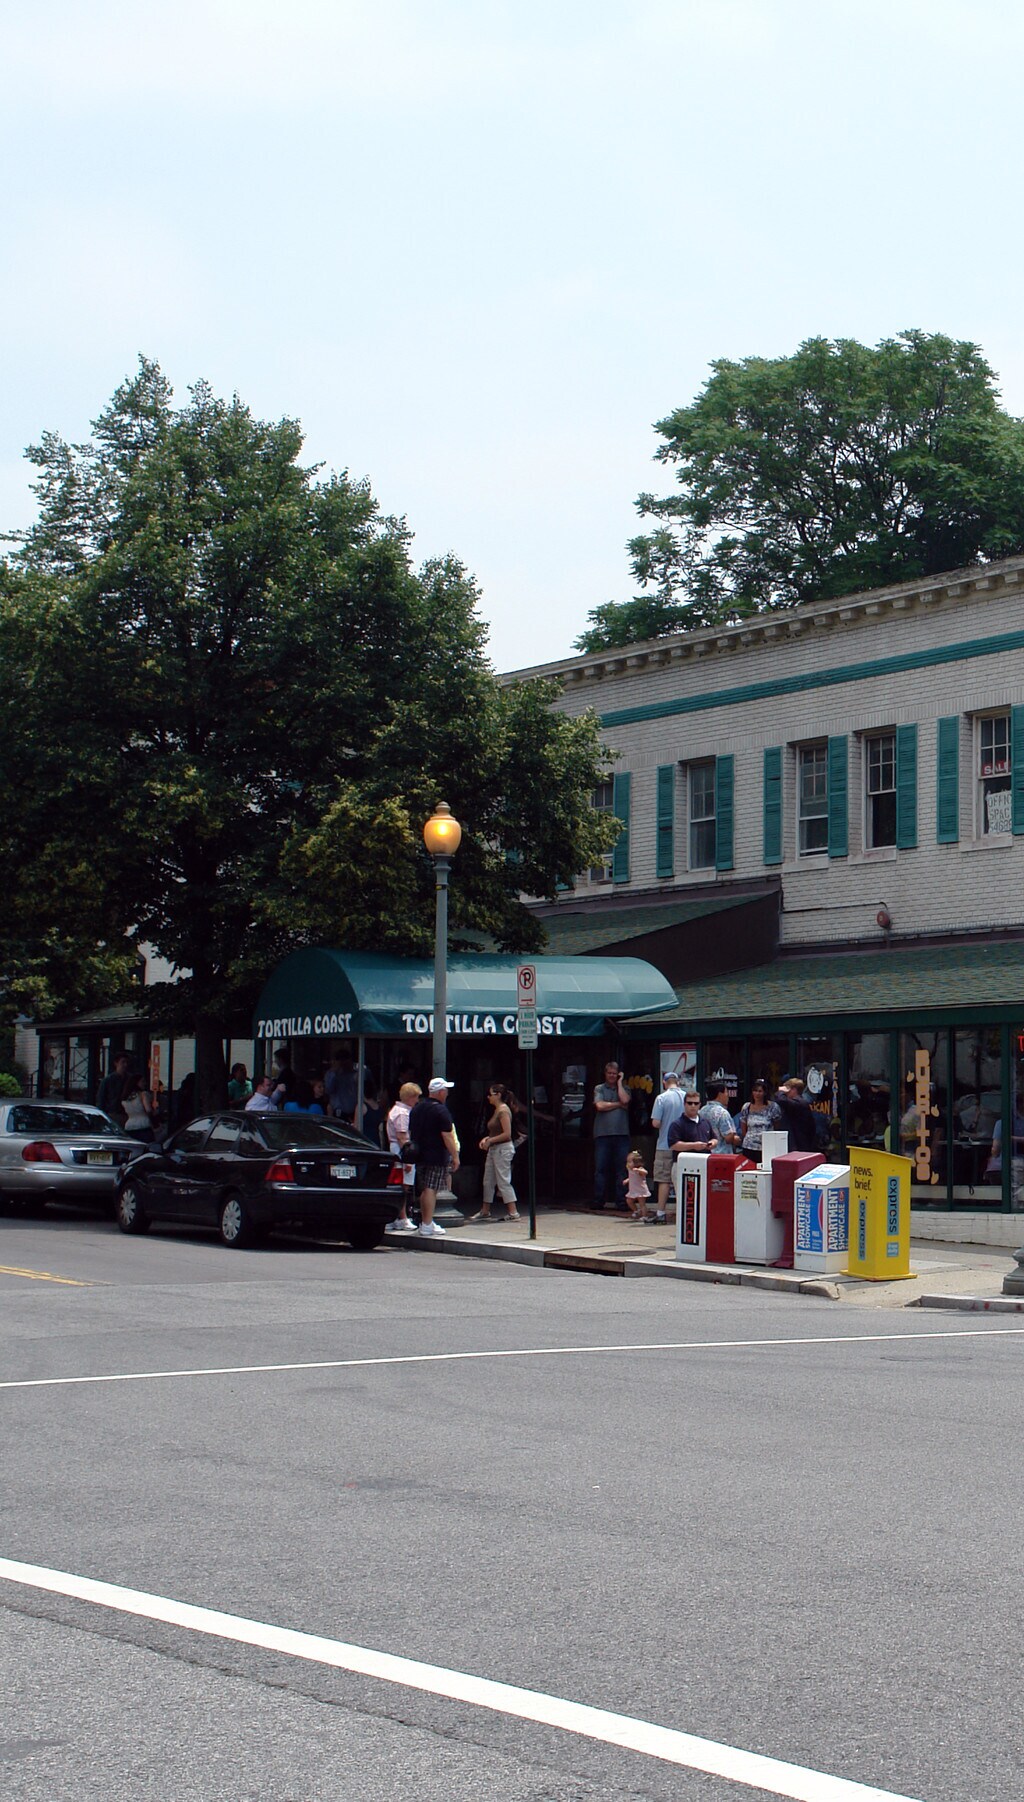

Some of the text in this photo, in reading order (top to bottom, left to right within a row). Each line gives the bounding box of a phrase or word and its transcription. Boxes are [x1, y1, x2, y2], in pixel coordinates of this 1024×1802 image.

[989, 808, 1011, 820] SPAC
[257, 1013, 352, 1038] TORTILLA COAST
[402, 1014, 565, 1034] TOTILLA CST
[915, 1050, 931, 1181] BURRITOS
[853, 1166, 873, 1177] news.
[855, 1178, 872, 1191] brief.
[686, 1182, 694, 1243] POLITICO
[798, 1189, 806, 1249] APARTMENT
[828, 1190, 838, 1250] APARTMENT
[838, 1204, 846, 1250] SHOWCASE
[888, 1179, 897, 1233] express
